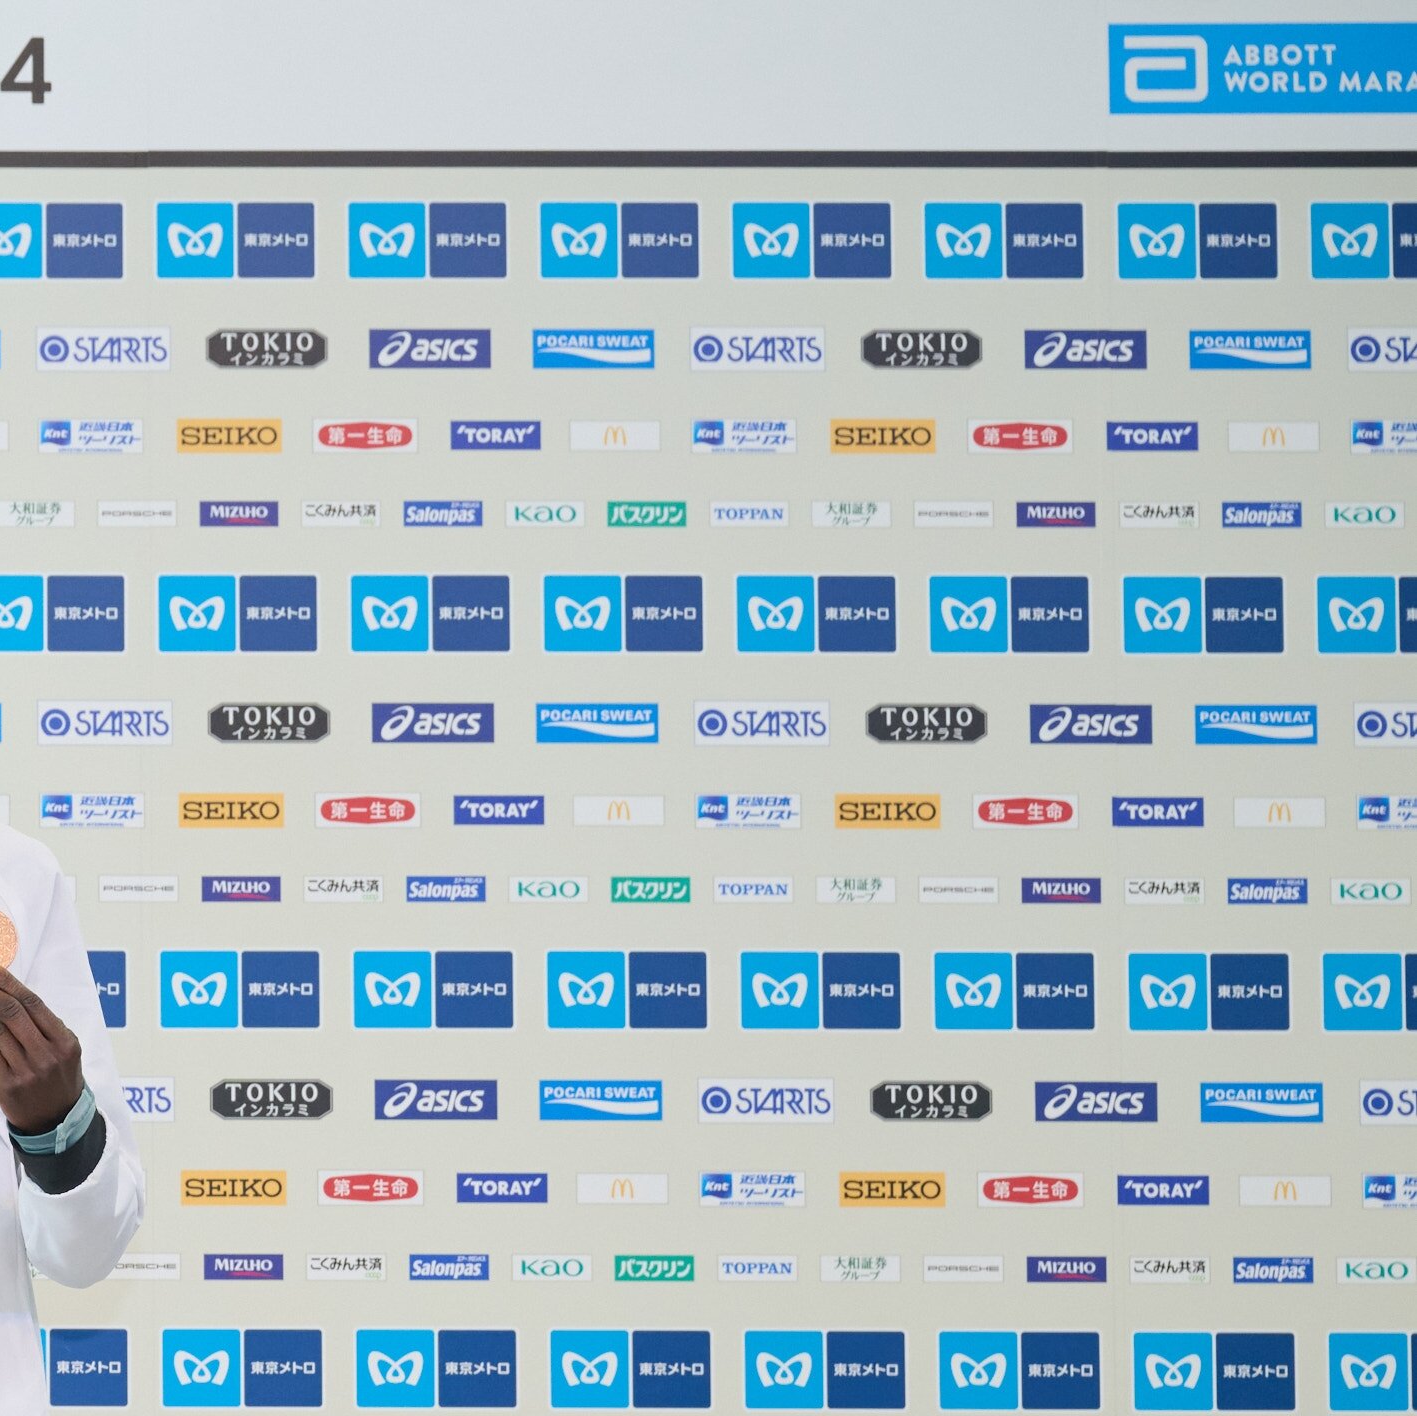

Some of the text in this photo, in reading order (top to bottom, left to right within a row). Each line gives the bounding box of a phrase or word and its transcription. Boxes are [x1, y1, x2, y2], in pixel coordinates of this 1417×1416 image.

[1223, 44, 1337, 66] ABBOTT
[1224, 71, 1417, 93] WORLD MARA
[411, 338, 478, 361] asics
[876, 333, 969, 352] TOKIO
[1194, 336, 1305, 348] POCARI SWEAT
[885, 353, 959, 366] インカラミ
[983, 427, 1057, 445] 第一生命
[611, 504, 683, 524] バスクリン
[714, 507, 783, 520] TOPPAN
[1027, 505, 1085, 518] MIZUHO
[1225, 506, 1293, 525] Salonpas
[331, 801, 405, 819] 第一生命
[840, 802, 936, 821] SEIKO
[226, 1083, 319, 1102] TOKIO
[235, 1103, 309, 1116] インカラミ
[1077, 1091, 1144, 1114] asics
[185, 1178, 283, 1198] SEIKO
